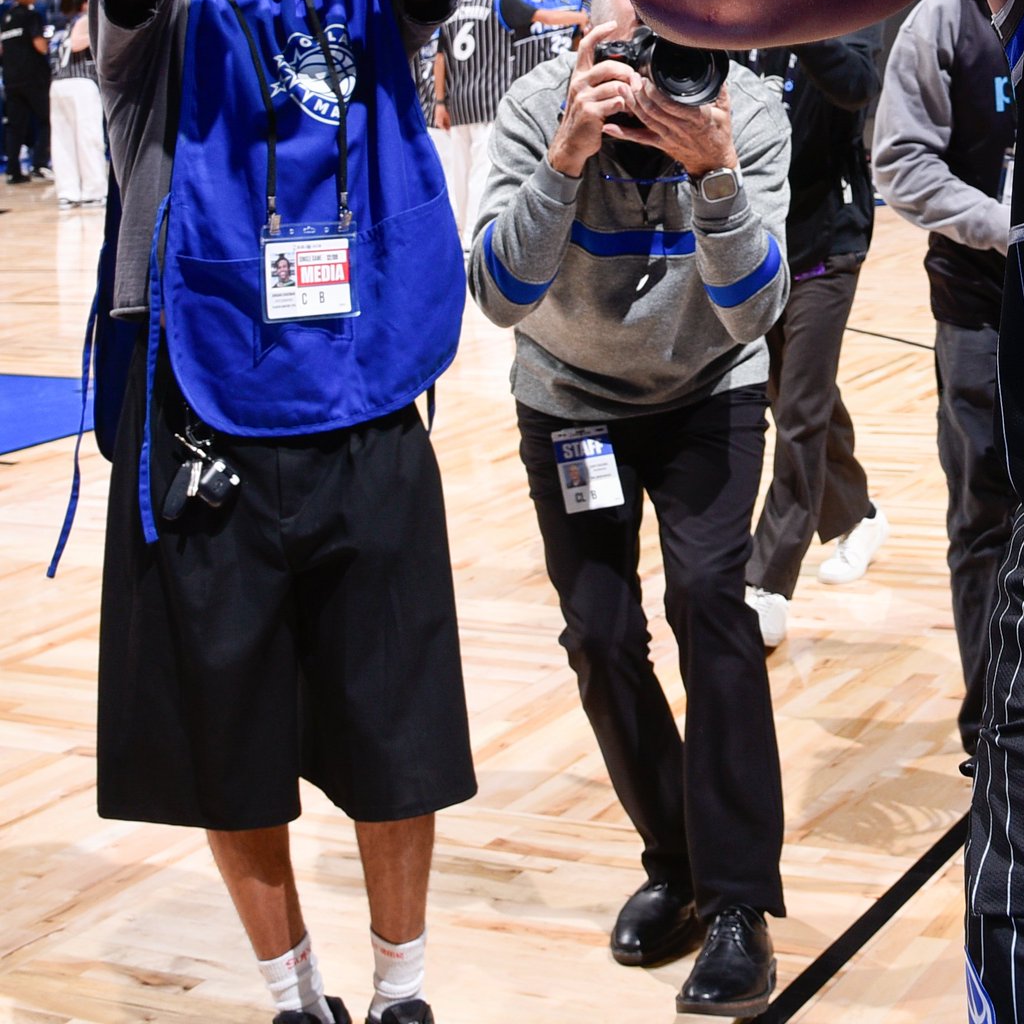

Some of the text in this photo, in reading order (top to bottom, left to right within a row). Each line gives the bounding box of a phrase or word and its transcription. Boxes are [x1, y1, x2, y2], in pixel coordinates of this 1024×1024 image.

[453, 21, 475, 61] 6
[301, 264, 345, 283] MEDIA
[302, 292, 308, 305] C
[319, 291, 325, 304] B
[562, 439, 604, 459] STAFF
